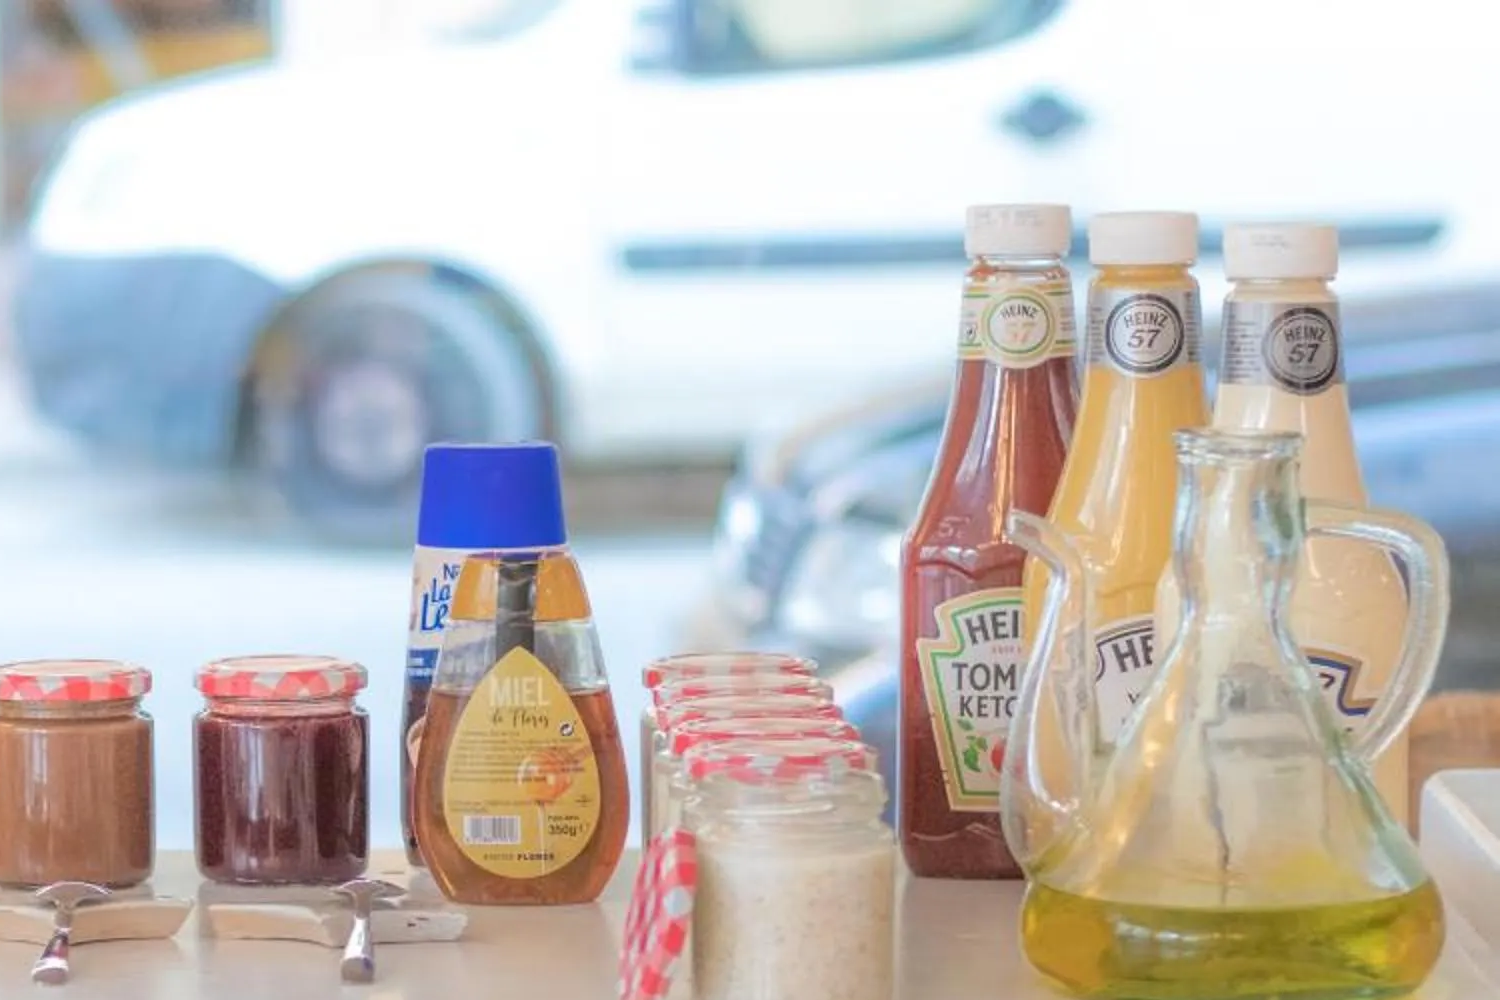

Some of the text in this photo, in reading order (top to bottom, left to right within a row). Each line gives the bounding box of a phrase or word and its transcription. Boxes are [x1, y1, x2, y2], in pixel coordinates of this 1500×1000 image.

[1124, 311, 1169, 329] HEINZ
[1127, 329, 1161, 349] 57
[1283, 325, 1328, 343] HEINZ
[1287, 343, 1320, 364] 57
[421, 592, 449, 631] Le
[965, 610, 1020, 645] HEI
[1112, 633, 1154, 673] HE
[952, 662, 1017, 692] TOM
[489, 675, 551, 708] MIEL
[960, 695, 1019, 719] KETC
